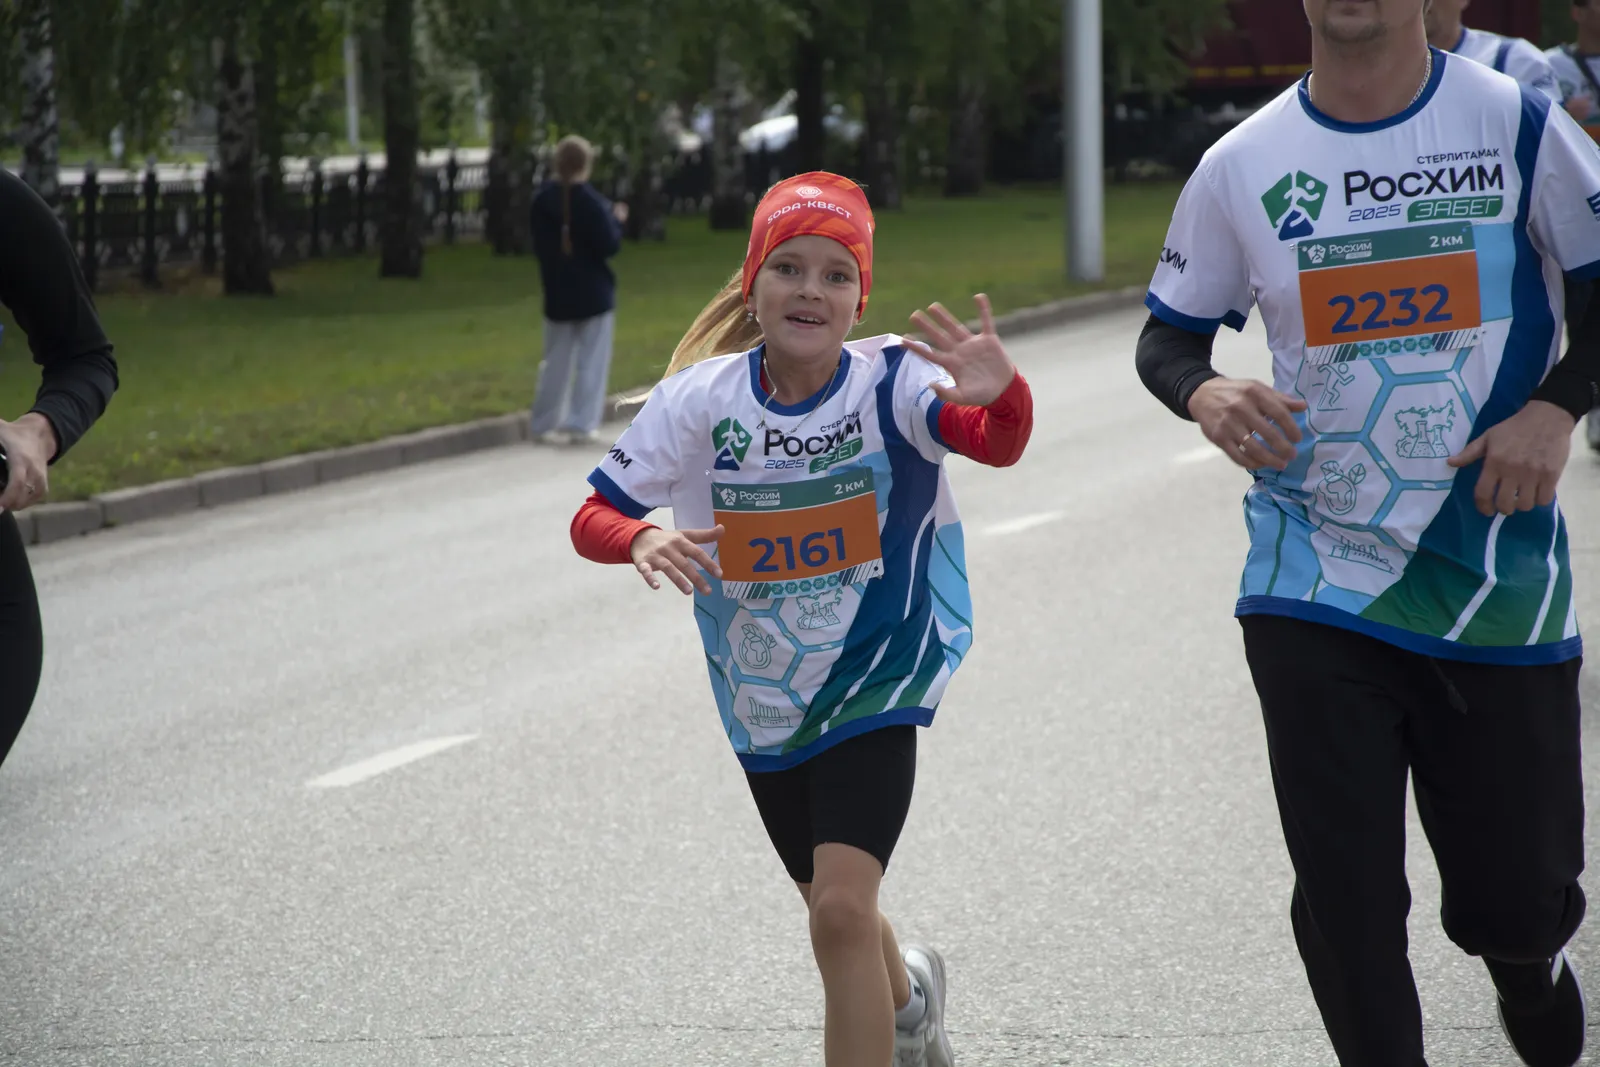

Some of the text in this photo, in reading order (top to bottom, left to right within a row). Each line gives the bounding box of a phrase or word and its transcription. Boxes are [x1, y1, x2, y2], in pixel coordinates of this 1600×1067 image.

[1416, 148, 1500, 165] СТЕРЛИТАМАК
[1348, 197, 1500, 222] 2025 ЗАБЕГ
[1429, 235, 1439, 248] 2
[1328, 283, 1453, 334] 2232
[764, 458, 806, 470] 2025
[834, 483, 843, 495] 2
[748, 527, 847, 573] 2161
